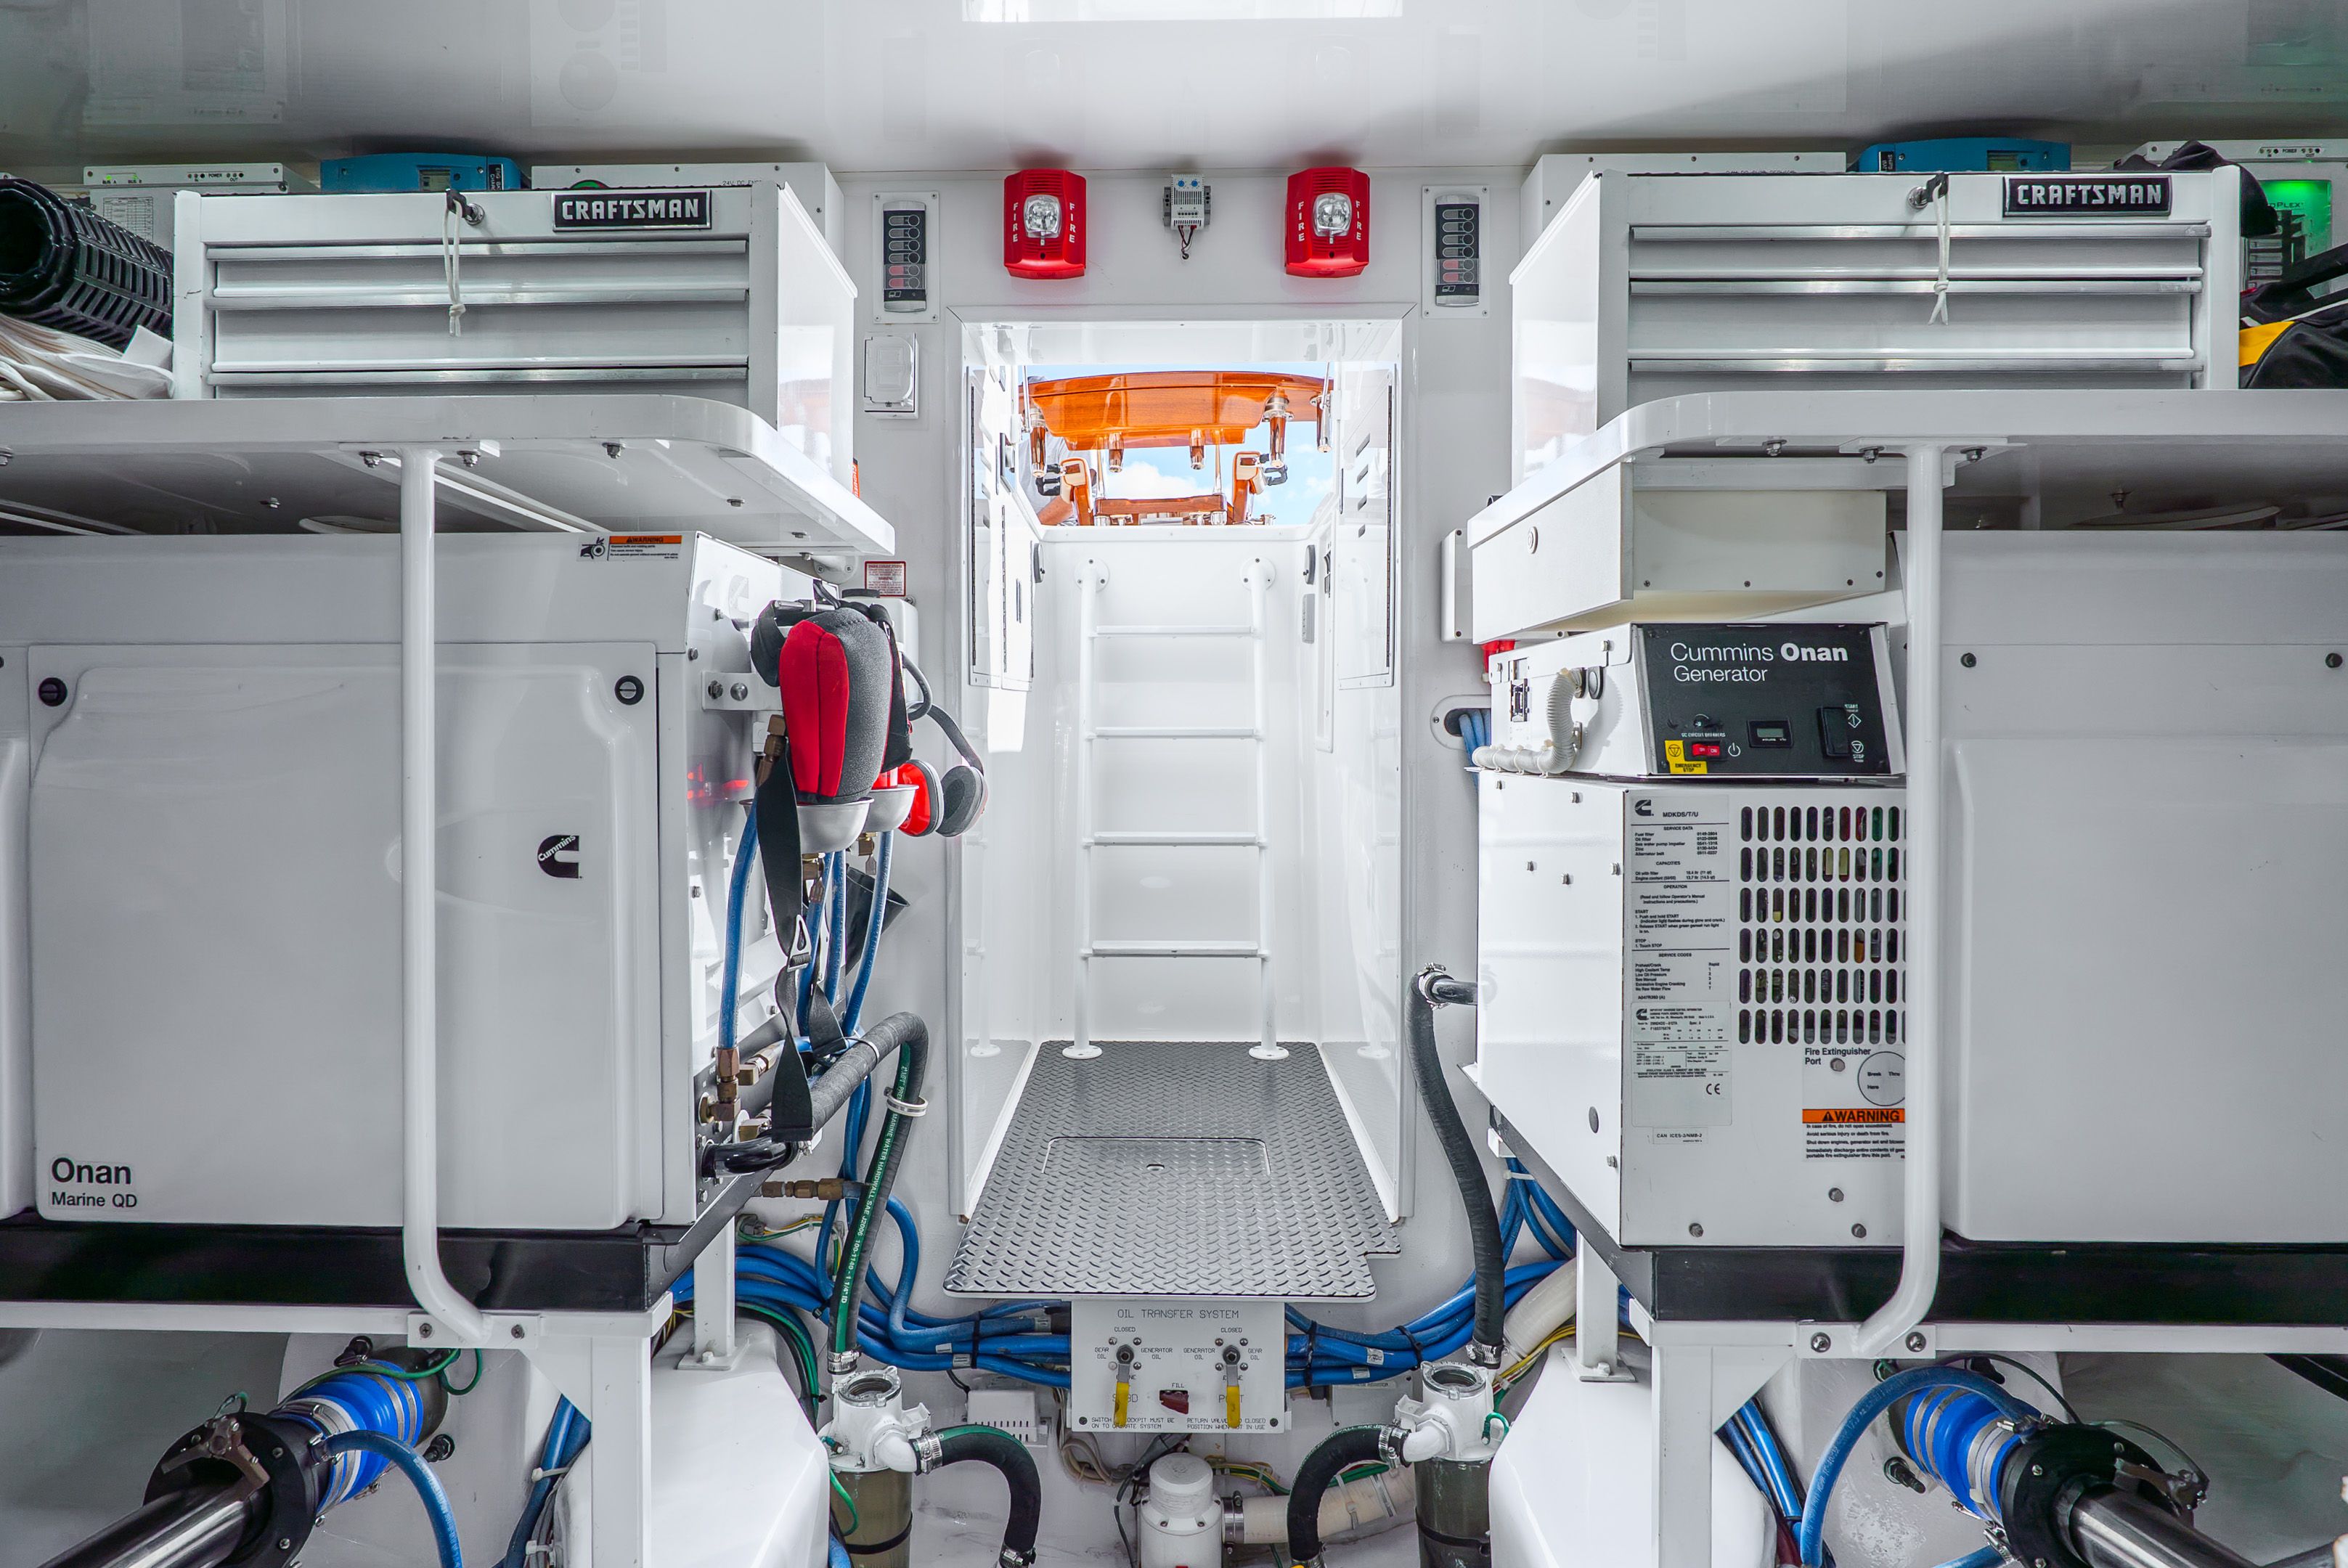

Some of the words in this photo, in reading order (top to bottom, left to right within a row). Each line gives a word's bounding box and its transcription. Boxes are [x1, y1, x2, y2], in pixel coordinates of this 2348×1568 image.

[2017, 184, 2161, 205] CRAFTSMAN
[562, 199, 698, 221] CRAFTSMAN
[1671, 643, 1774, 661] Cummins
[1781, 643, 1848, 661] Onan
[1674, 666, 1768, 682] Generator
[538, 835, 576, 861] Cummins
[1822, 1048, 1871, 1057] Extinguisher
[1706, 1083, 1721, 1095] CE
[1835, 1110, 1900, 1122] WARNING
[886, 1114, 898, 1140] MARINE
[880, 1138, 892, 1160] WATER
[52, 1157, 131, 1184] Onan
[868, 1161, 884, 1199] HARDWALL
[52, 1192, 105, 1206] Marine
[112, 1193, 137, 1208] QD
[864, 1201, 873, 1215] SAE
[848, 1240, 860, 1270] 100-1140
[1117, 1310, 1133, 1318] OIL
[1141, 1310, 1193, 1318] TRANSFER
[1199, 1310, 1239, 1319] SYSTEM
[1218, 1395, 1244, 1403] PT
